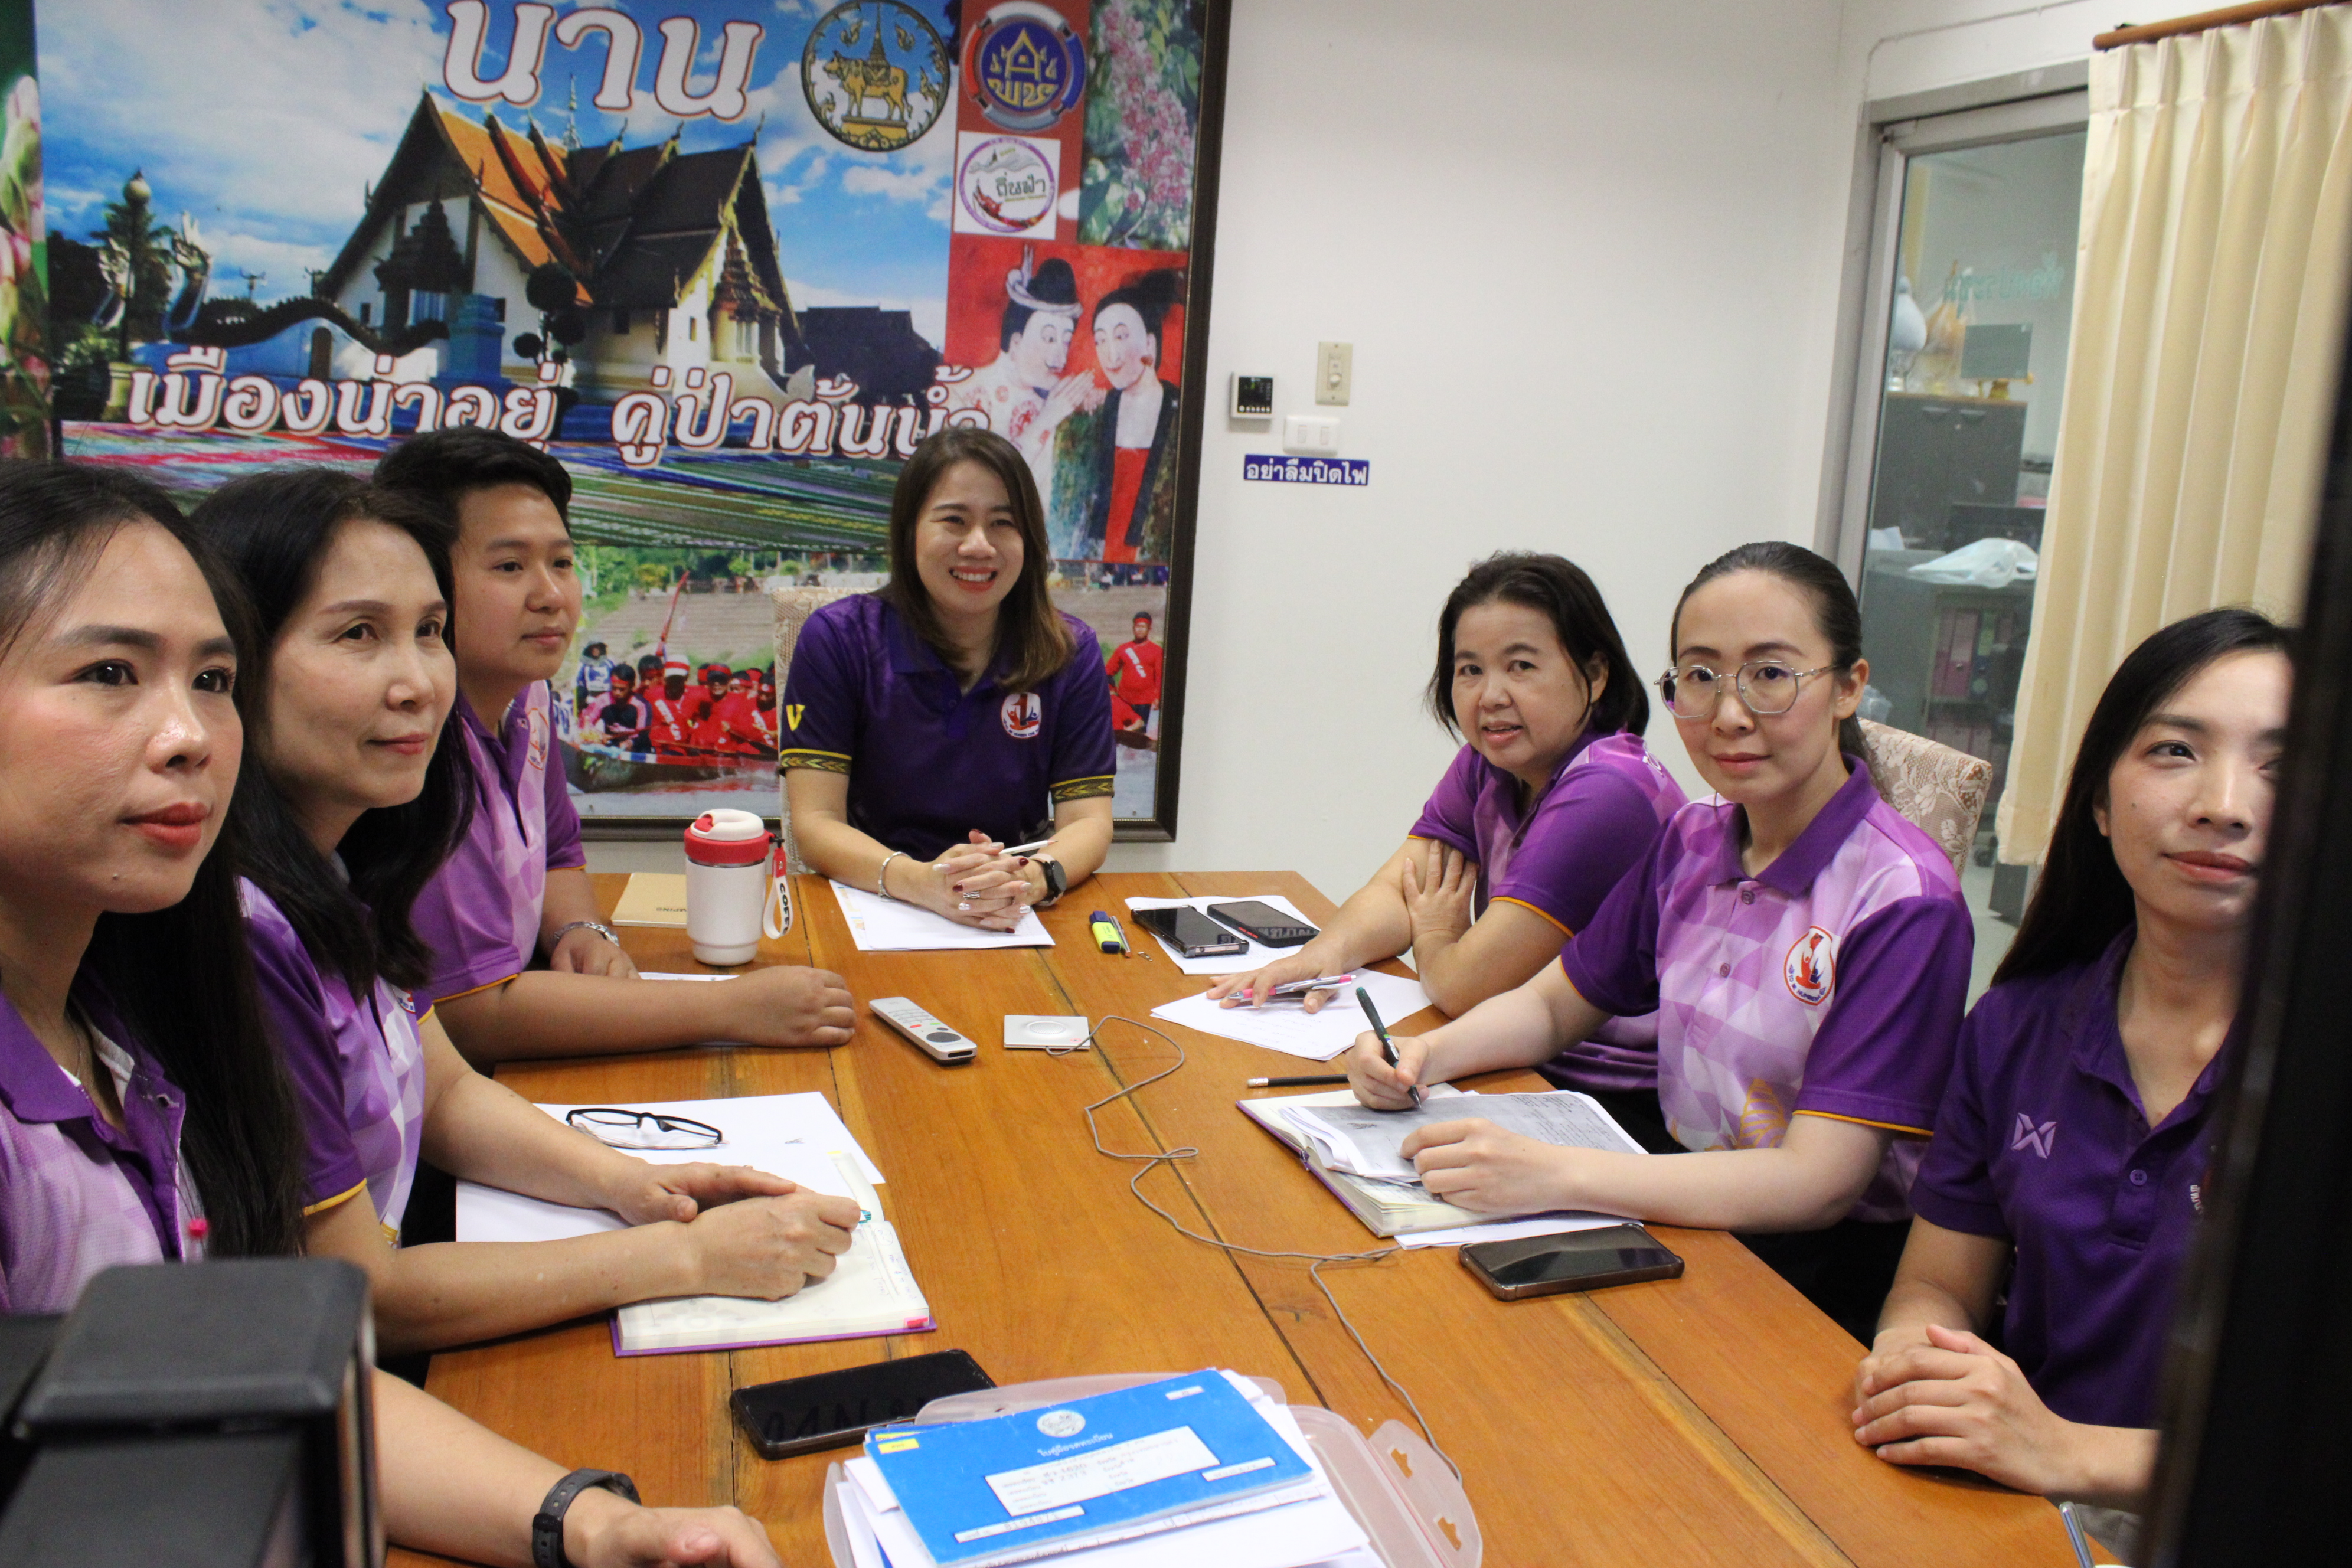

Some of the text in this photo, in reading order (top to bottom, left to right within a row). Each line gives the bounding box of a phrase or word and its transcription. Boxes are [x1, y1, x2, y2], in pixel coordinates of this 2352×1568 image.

[1246, 458, 1368, 485] อย่าลืมปิดไฟ
